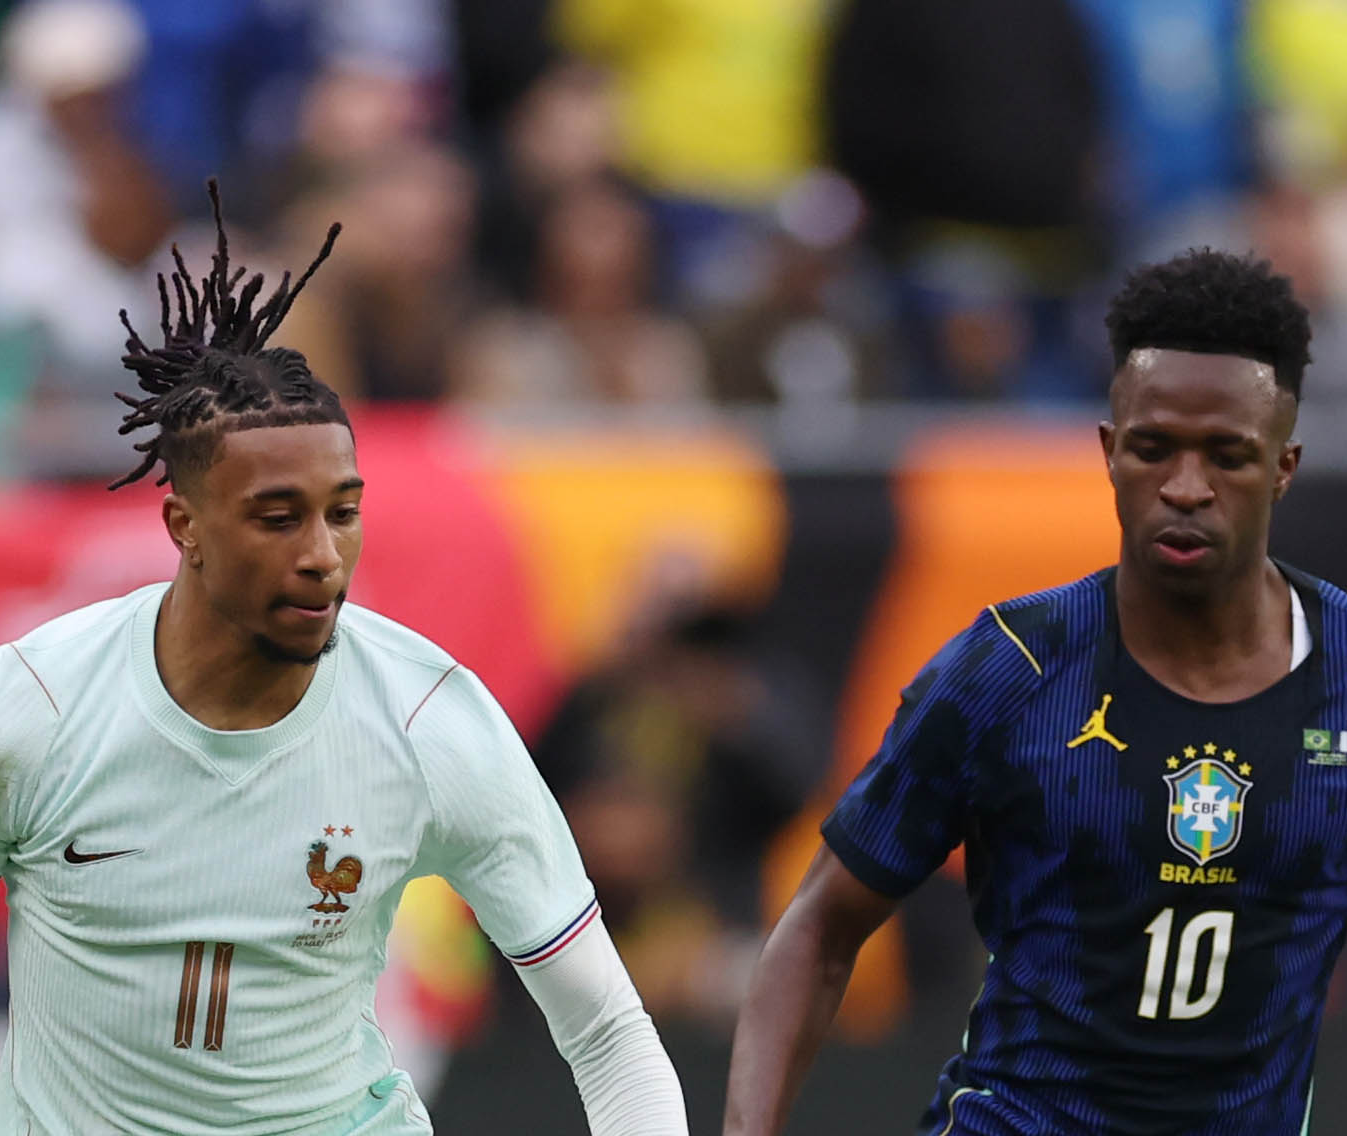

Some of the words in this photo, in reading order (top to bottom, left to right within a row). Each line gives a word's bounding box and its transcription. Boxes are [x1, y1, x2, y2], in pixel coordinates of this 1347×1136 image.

[1191, 802, 1221, 814] CBF
[1159, 863, 1237, 884] BRASIL
[1138, 907, 1234, 1019] 10
[174, 941, 234, 1051] 11
